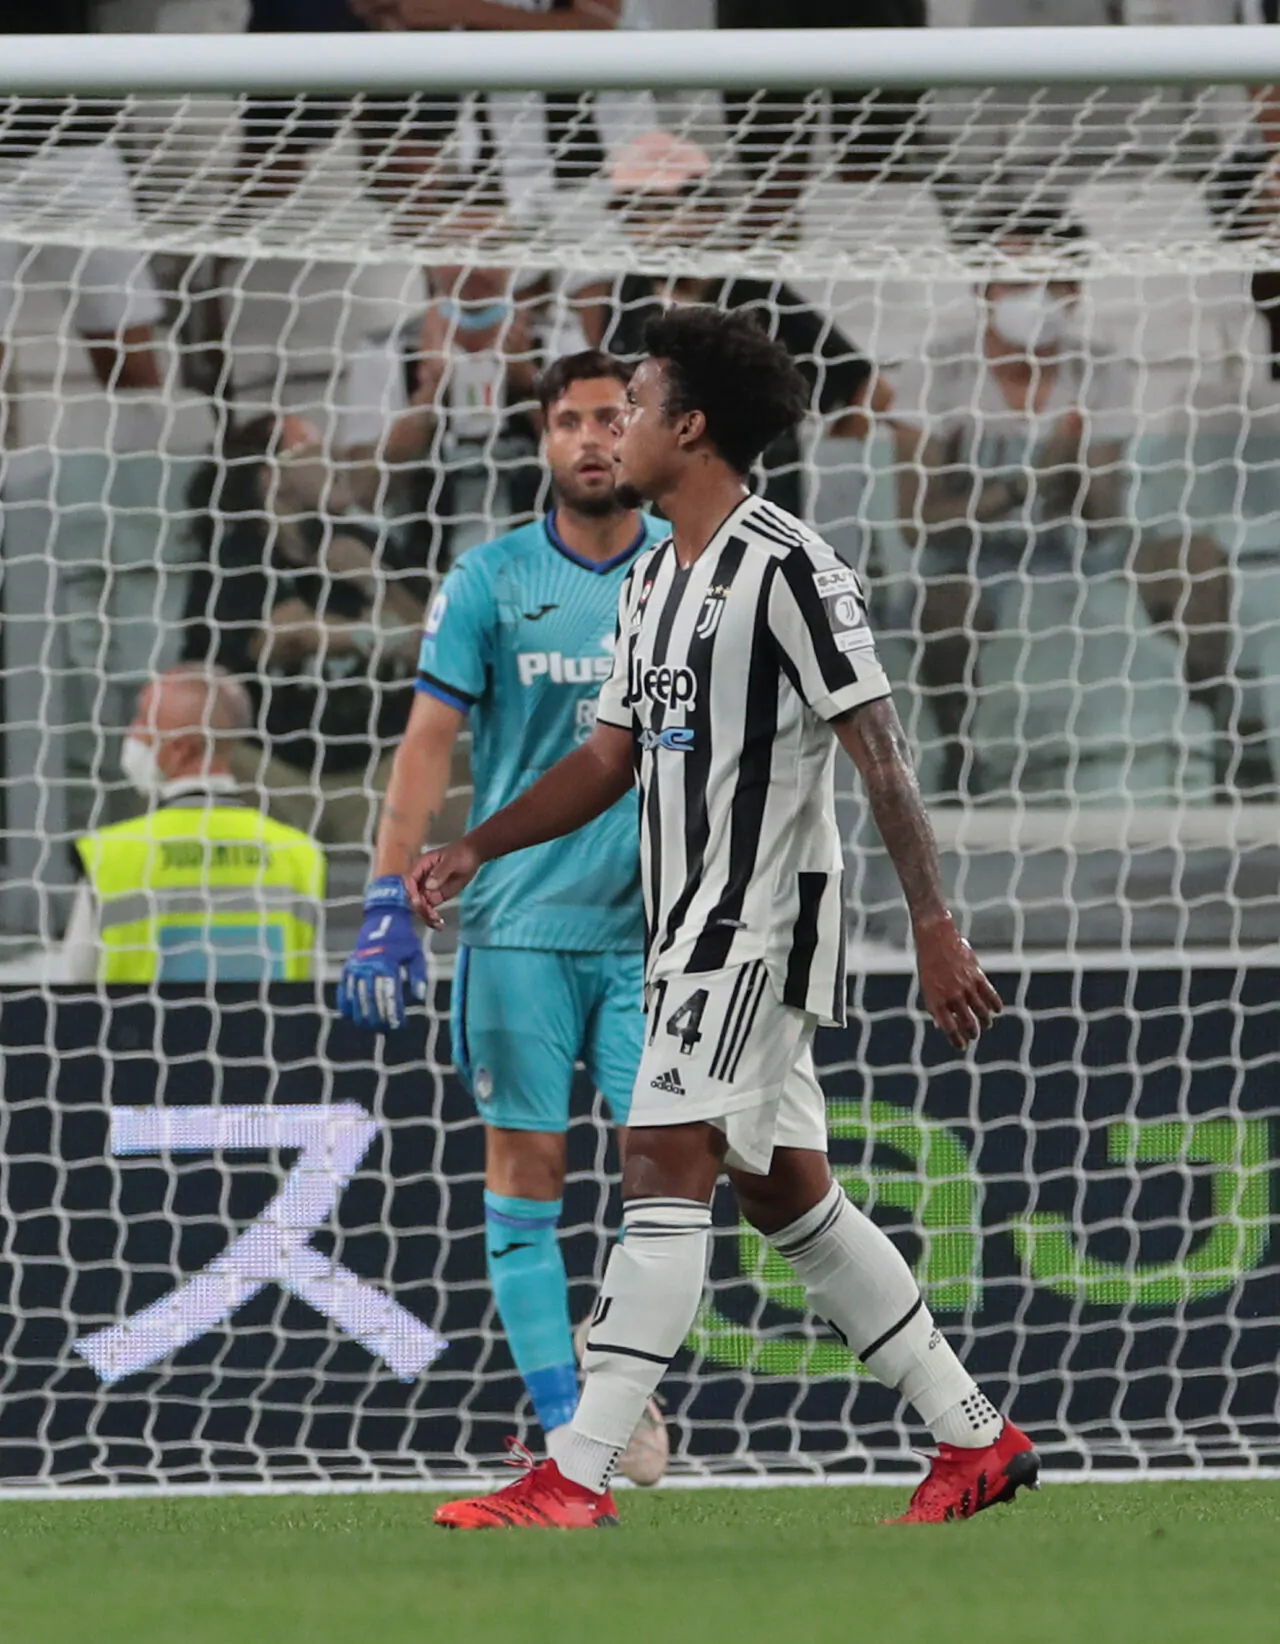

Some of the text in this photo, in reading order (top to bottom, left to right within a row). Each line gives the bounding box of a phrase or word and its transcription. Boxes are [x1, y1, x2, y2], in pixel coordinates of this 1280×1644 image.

[621, 657, 696, 712] Jeep
[646, 978, 710, 1055] 14
[650, 1080, 686, 1096] adidas
